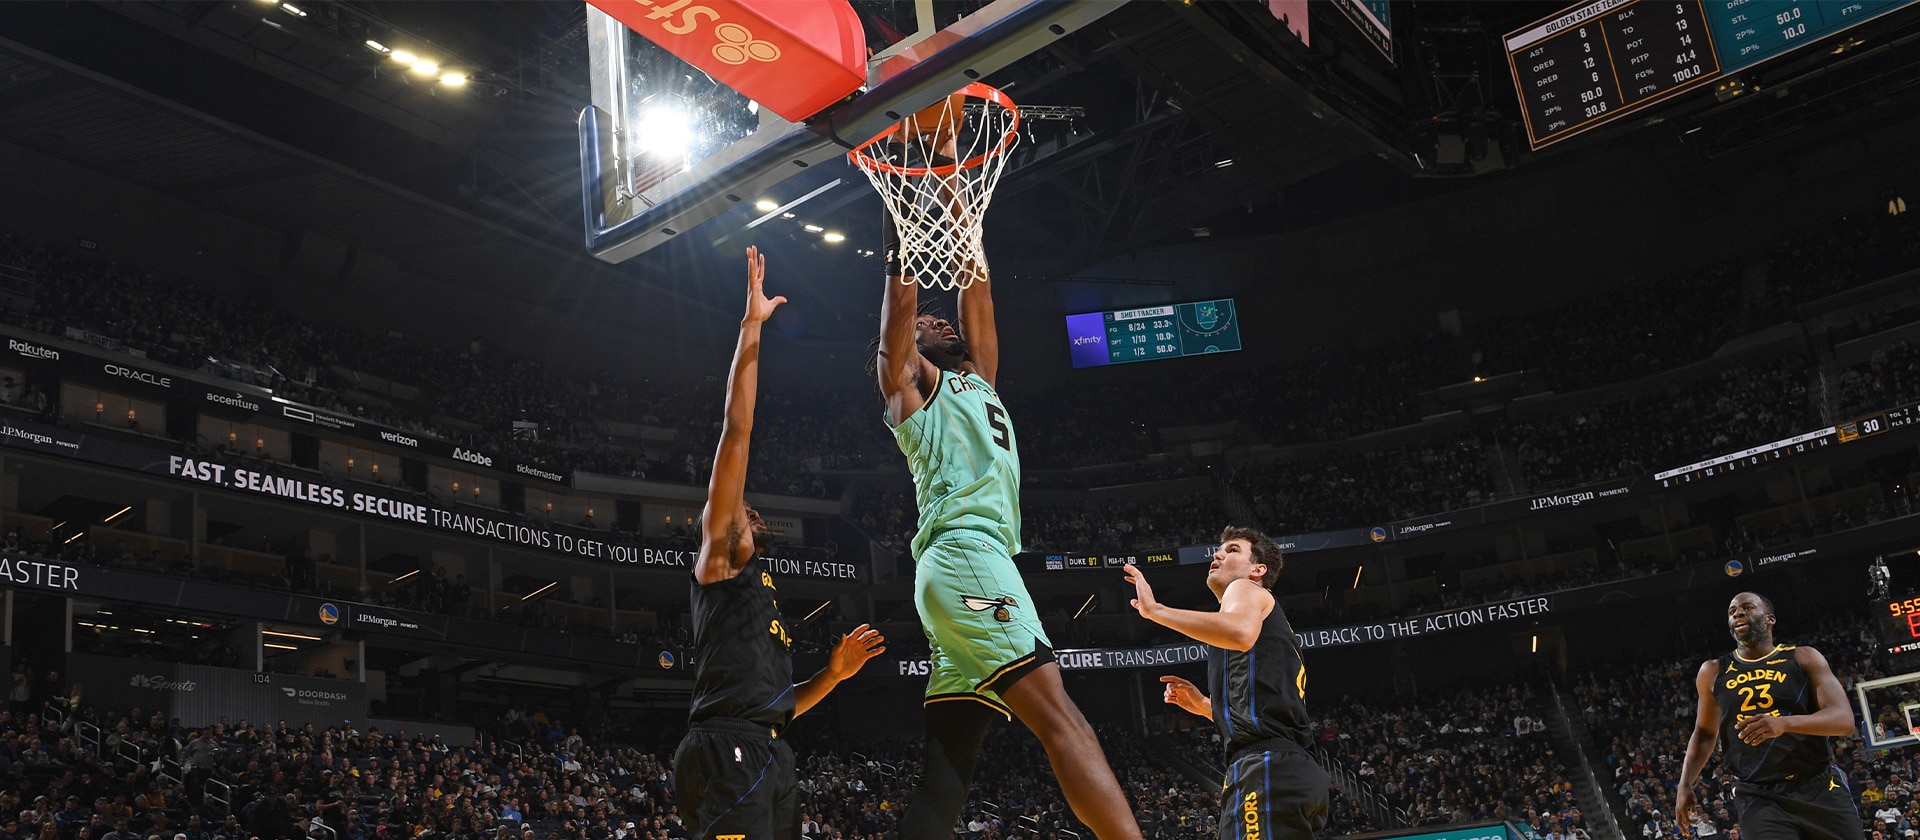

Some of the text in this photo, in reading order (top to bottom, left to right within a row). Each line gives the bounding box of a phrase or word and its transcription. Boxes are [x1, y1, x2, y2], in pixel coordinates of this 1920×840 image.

[1545, 13, 1576, 34] GOLDEN
[1577, 4, 1600, 23] STATE
[1618, 10, 1635, 21] BLK
[1622, 4, 1683, 35] TO 3
[1732, 8, 1801, 25] STL 50.0
[1842, 3, 1861, 16] FT%
[1626, 19, 1688, 51] POT 13
[1736, 23, 1806, 40] 2P% 10.0
[1529, 28, 1588, 59] AST 8
[1631, 34, 1693, 65] PITP 14
[1741, 44, 1760, 56] 3P%
[1533, 42, 1591, 73] OREB 3
[1635, 49, 1697, 80] FG% 41.4
[1537, 57, 1596, 88] DREB 12
[1639, 64, 1701, 96] FT% 100.0
[1541, 72, 1599, 102] STL 6
[1544, 87, 1603, 116] 2P% 50.0
[1548, 102, 1607, 131] 3P% 30.8
[1120, 308, 1165, 319] SHOT TRACKER
[1128, 322, 1146, 332] 8/24
[1073, 335, 1102, 346] xfinity
[1131, 334, 1147, 344] 1/10
[9, 339, 60, 361] Rakuten
[1133, 347, 1146, 356] 1/2
[104, 363, 171, 388] ORACLE
[206, 392, 259, 412] accenture
[1889, 408, 1909, 419] TOL 7
[1905, 416, 1911, 425] 0
[984, 401, 1011, 452] 5
[1863, 418, 1880, 434] 30
[0, 426, 79, 450] J.P.Morgan PAYMENTS
[380, 430, 418, 447] verizon
[452, 447, 492, 467] Adobe
[1663, 438, 1828, 488] 8 3 12 6 0 3 13 14
[516, 463, 563, 482] ticketmaster
[1658, 471, 1670, 479] AST
[1530, 486, 1629, 511] J.P.Morgan PAYMENTS
[169, 455, 229, 488] FAST,
[233, 469, 350, 511] SEAMLESS,
[352, 492, 428, 524] SECURE
[431, 508, 551, 548] TRANSACTIONS
[554, 533, 573, 552] TO
[577, 538, 603, 558] GET
[607, 544, 637, 563] YOU
[643, 548, 685, 567] BACK
[805, 561, 856, 579] FASTER
[1069, 558, 1086, 566] DUKE
[1087, 557, 1097, 566] 97
[1146, 554, 1173, 563] FINAL
[1758, 552, 1797, 566] J.P.Morgan
[357, 613, 398, 628] J.P.Morgan
[1055, 652, 1104, 669] CURE
[1106, 644, 1209, 667] TRANSACTION
[1294, 633, 1315, 648] OU
[1320, 627, 1361, 646] BACK
[1363, 624, 1385, 641] TO
[1387, 619, 1420, 639] THE
[1425, 608, 1484, 633] ACTION
[1488, 597, 1549, 622] FASTER
[149, 675, 196, 692] Sports
[253, 673, 270, 684] 104
[1725, 669, 1787, 689] GOLDEN
[298, 689, 347, 701] DOORDASH
[1737, 683, 1774, 712] 23
